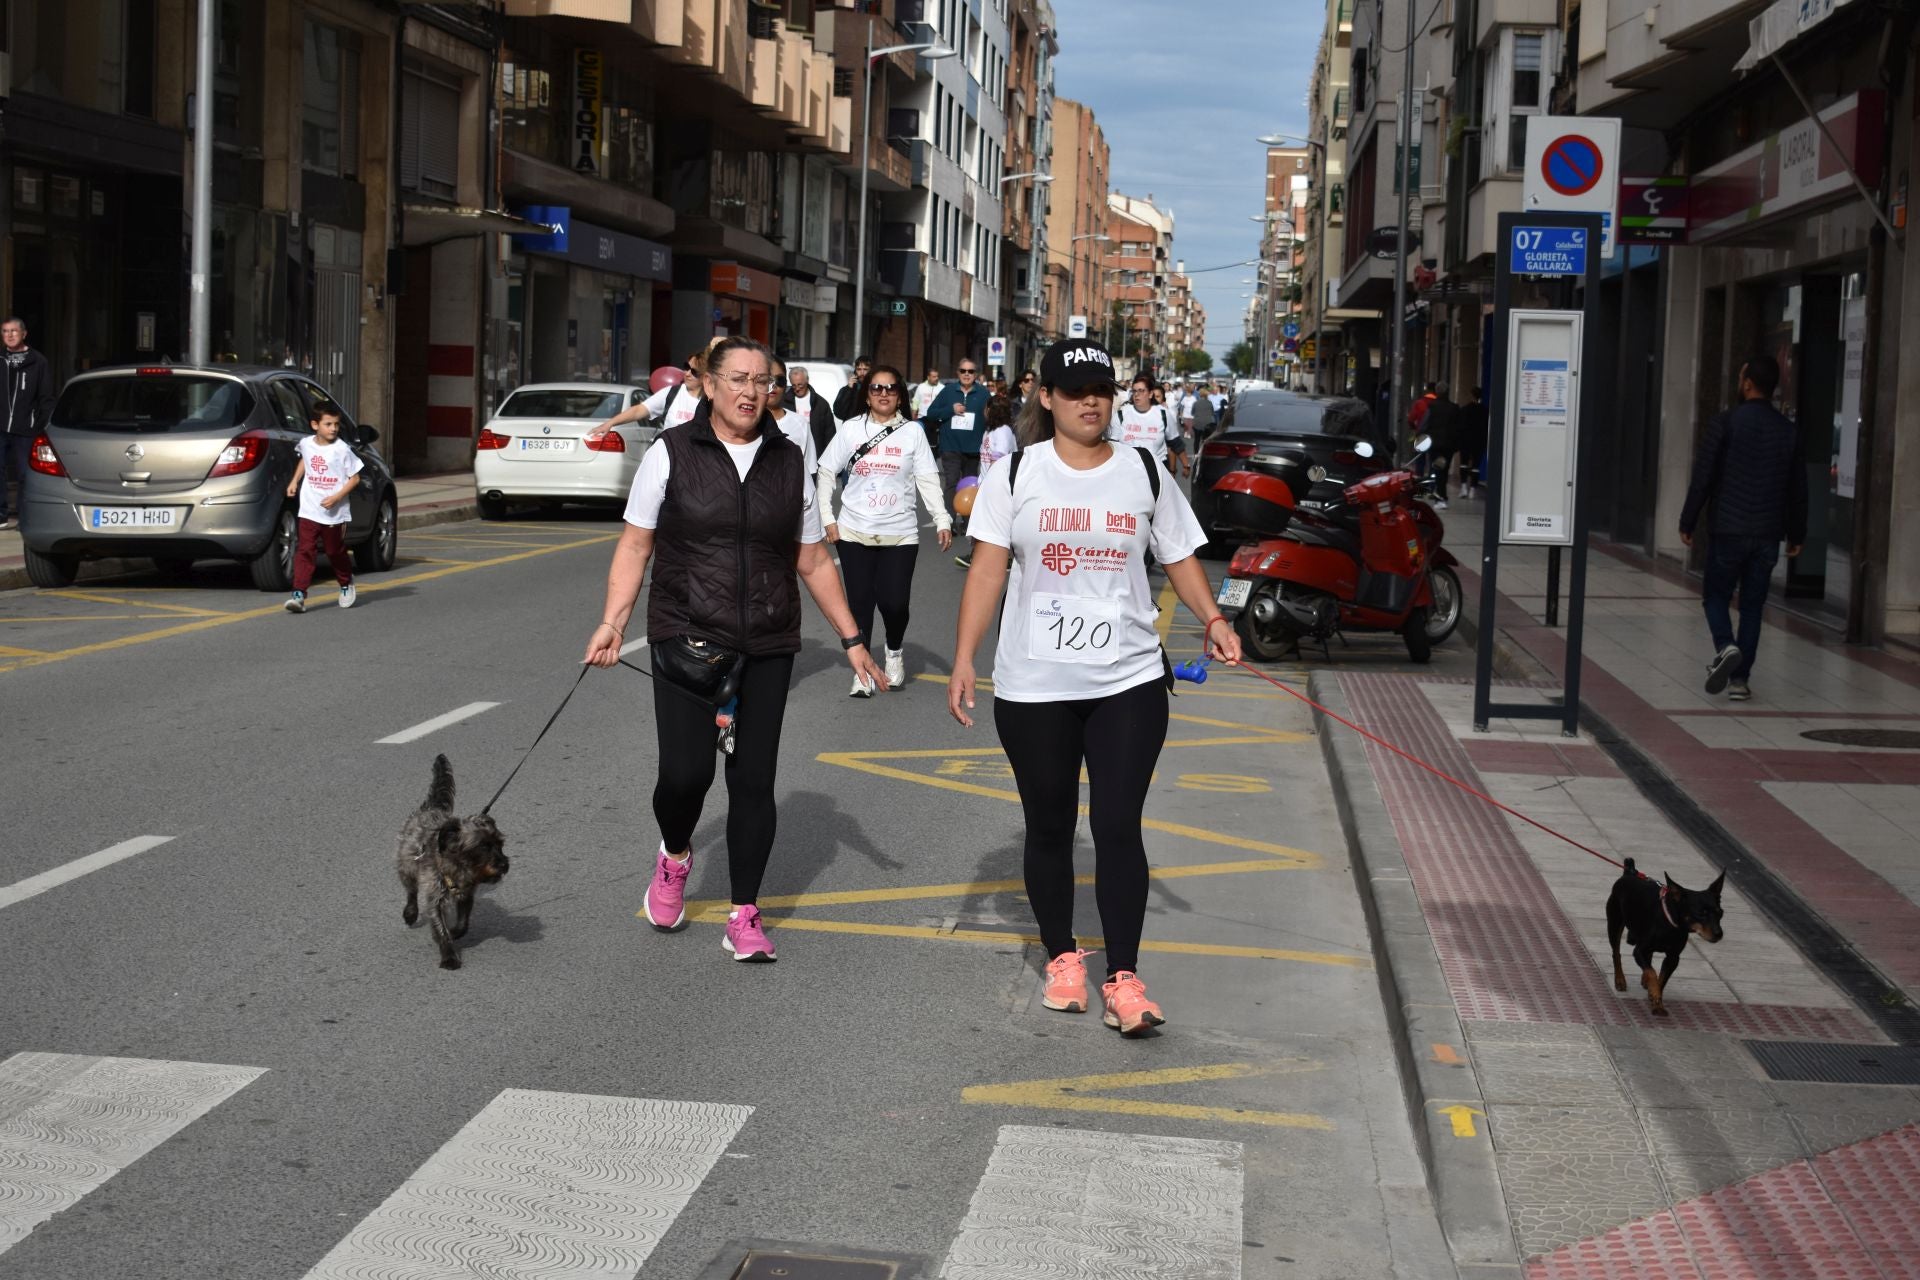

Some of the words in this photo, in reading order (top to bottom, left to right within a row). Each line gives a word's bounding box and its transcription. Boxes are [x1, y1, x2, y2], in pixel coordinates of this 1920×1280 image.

[576, 50, 597, 170] GESTORIA
[1783, 128, 1815, 169] LABORAL
[1516, 231, 1543, 250] 07
[1525, 252, 1568, 262] GLORIETA
[1526, 261, 1572, 271] GALLARZA
[1063, 347, 1110, 367] PARIS
[528, 440, 550, 449] 6328
[554, 441, 570, 449] GJY
[868, 493, 897, 508] 800
[102, 511, 136, 525] 5021
[143, 511, 170, 524] HHD
[1043, 507, 1091, 532] SOLIDARIA
[1106, 511, 1136, 530] berlin
[1075, 546, 1128, 559] Cáritas
[1229, 581, 1249, 592] 9801
[1036, 609, 1061, 617] Calahorra
[1049, 616, 1112, 650] 120
[935, 759, 1272, 793] BS
